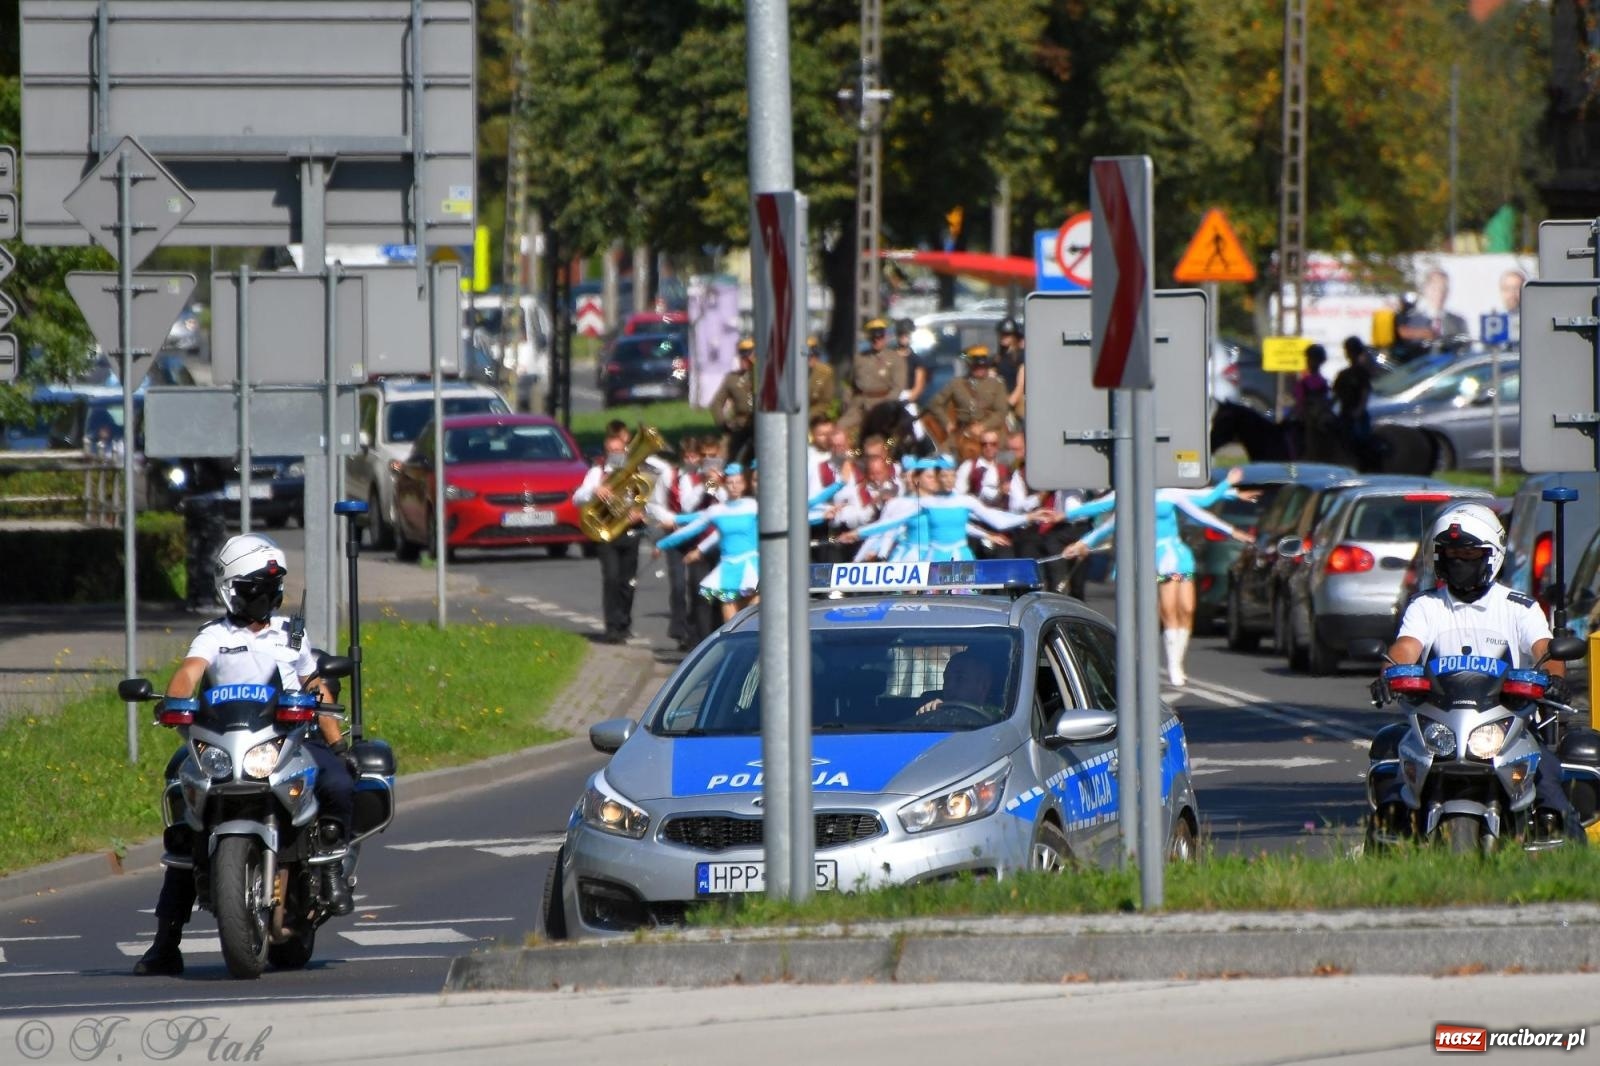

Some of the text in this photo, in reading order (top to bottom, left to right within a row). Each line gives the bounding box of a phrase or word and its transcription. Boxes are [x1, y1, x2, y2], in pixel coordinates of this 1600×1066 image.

[836, 565, 921, 585] POLICJA
[1439, 656, 1498, 675] POLICJA
[212, 686, 268, 704] POLICJA
[707, 772, 849, 790] POLJA
[1078, 771, 1112, 813] POLICJA
